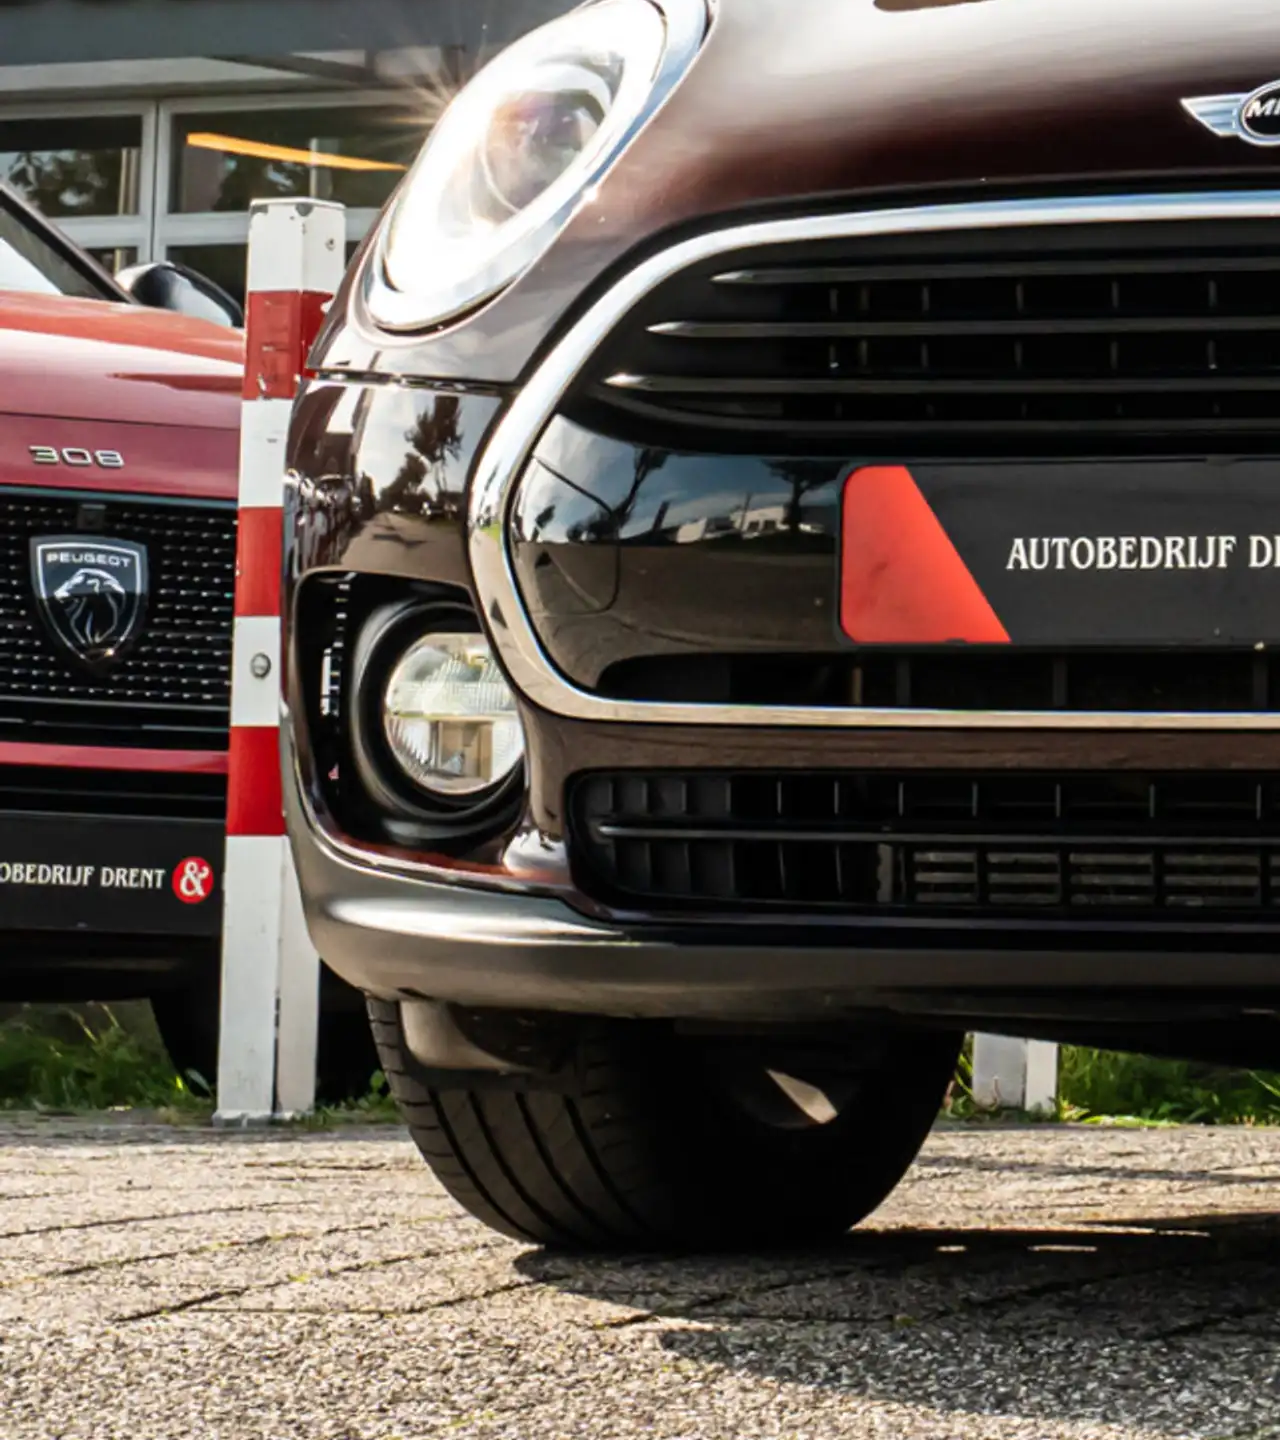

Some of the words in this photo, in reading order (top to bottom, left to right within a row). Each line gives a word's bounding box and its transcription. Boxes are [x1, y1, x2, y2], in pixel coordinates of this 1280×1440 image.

[28, 445, 125, 468] 308
[46, 551, 132, 568] PEUGEOT
[1005, 534, 1238, 571] AUTOBEDRIJF
[100, 865, 167, 890] DRENT
[179, 860, 210, 898] &
